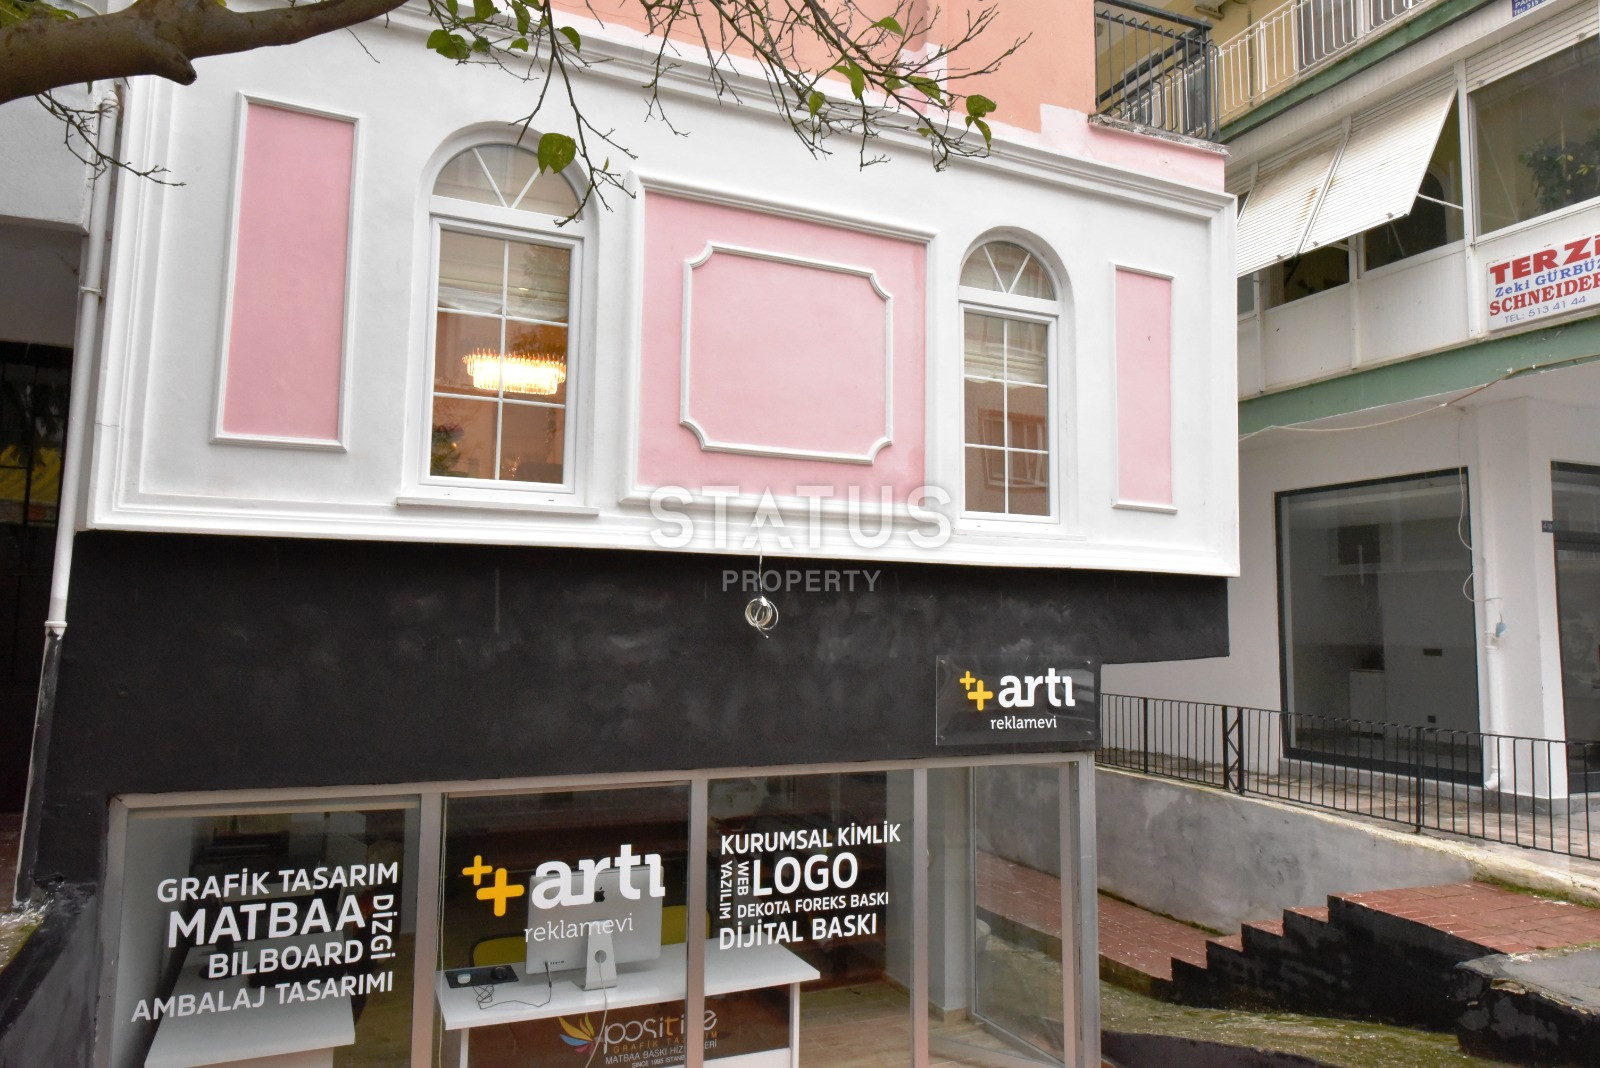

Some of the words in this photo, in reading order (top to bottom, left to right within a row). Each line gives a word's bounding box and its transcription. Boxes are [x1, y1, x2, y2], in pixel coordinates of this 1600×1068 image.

[1495, 280, 1530, 298] Zeki
[1504, 313, 1525, 323] TEL:
[1528, 306, 1549, 317] 513
[1553, 301, 1566, 310] 41
[1571, 296, 1586, 305] 44
[998, 668, 1076, 708] artı
[990, 716, 1058, 730] reklamevi
[721, 828, 833, 855] KURUMSAL
[838, 820, 901, 846] KİMLİK
[157, 867, 270, 903] GRAFİK
[278, 861, 399, 893] TASARIM
[532, 844, 666, 909] artı
[719, 860, 733, 920] YAZILIM
[737, 861, 749, 896] WEB
[753, 852, 858, 897] LOGO
[168, 894, 366, 948] MATBAA
[737, 901, 791, 918] DEKOTA
[795, 895, 846, 913] FOREKS
[851, 891, 889, 908] BASKI
[370, 894, 398, 960] DİZGİ
[524, 913, 634, 942] reklamevi
[719, 919, 804, 950] DİJİTAL
[812, 912, 877, 940] BASKI
[208, 939, 363, 979] BILBOARD
[131, 985, 266, 1023] AMBALAJ
[275, 971, 393, 1005] TASARIMI
[604, 1010, 718, 1054] positie
[605, 1052, 641, 1065] MATBAA
[643, 1047, 667, 1059] BASKI
